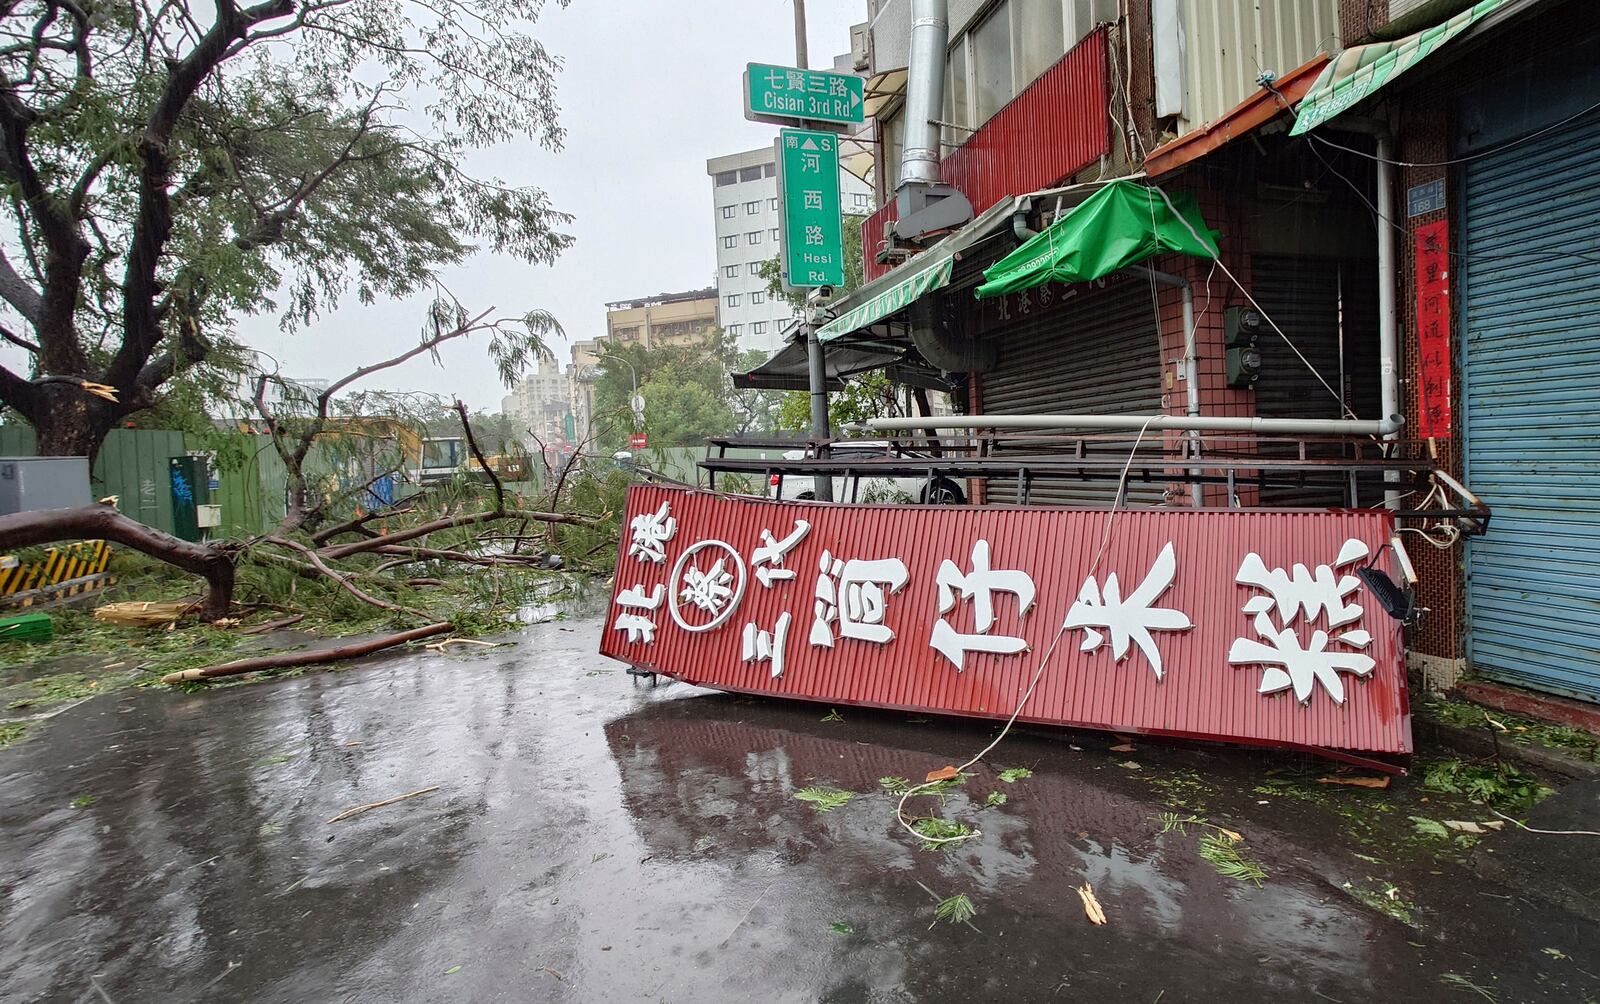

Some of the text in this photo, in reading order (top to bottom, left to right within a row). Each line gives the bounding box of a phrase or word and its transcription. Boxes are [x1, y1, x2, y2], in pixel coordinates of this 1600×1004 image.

[764, 69, 848, 98] 七賢三路
[764, 91, 854, 118] Cisian 3rd Rd.
[785, 136, 798, 149] 南
[821, 139, 834, 152] S.
[802, 152, 824, 246] 河西路
[1413, 199, 1432, 213] 168
[804, 253, 832, 264] Hesi
[809, 271, 828, 282] Rd.
[614, 500, 678, 646] 北港
[680, 557, 735, 617] 蔡
[742, 519, 812, 679] 三代
[809, 538, 1377, 705] 筒仔米糕
